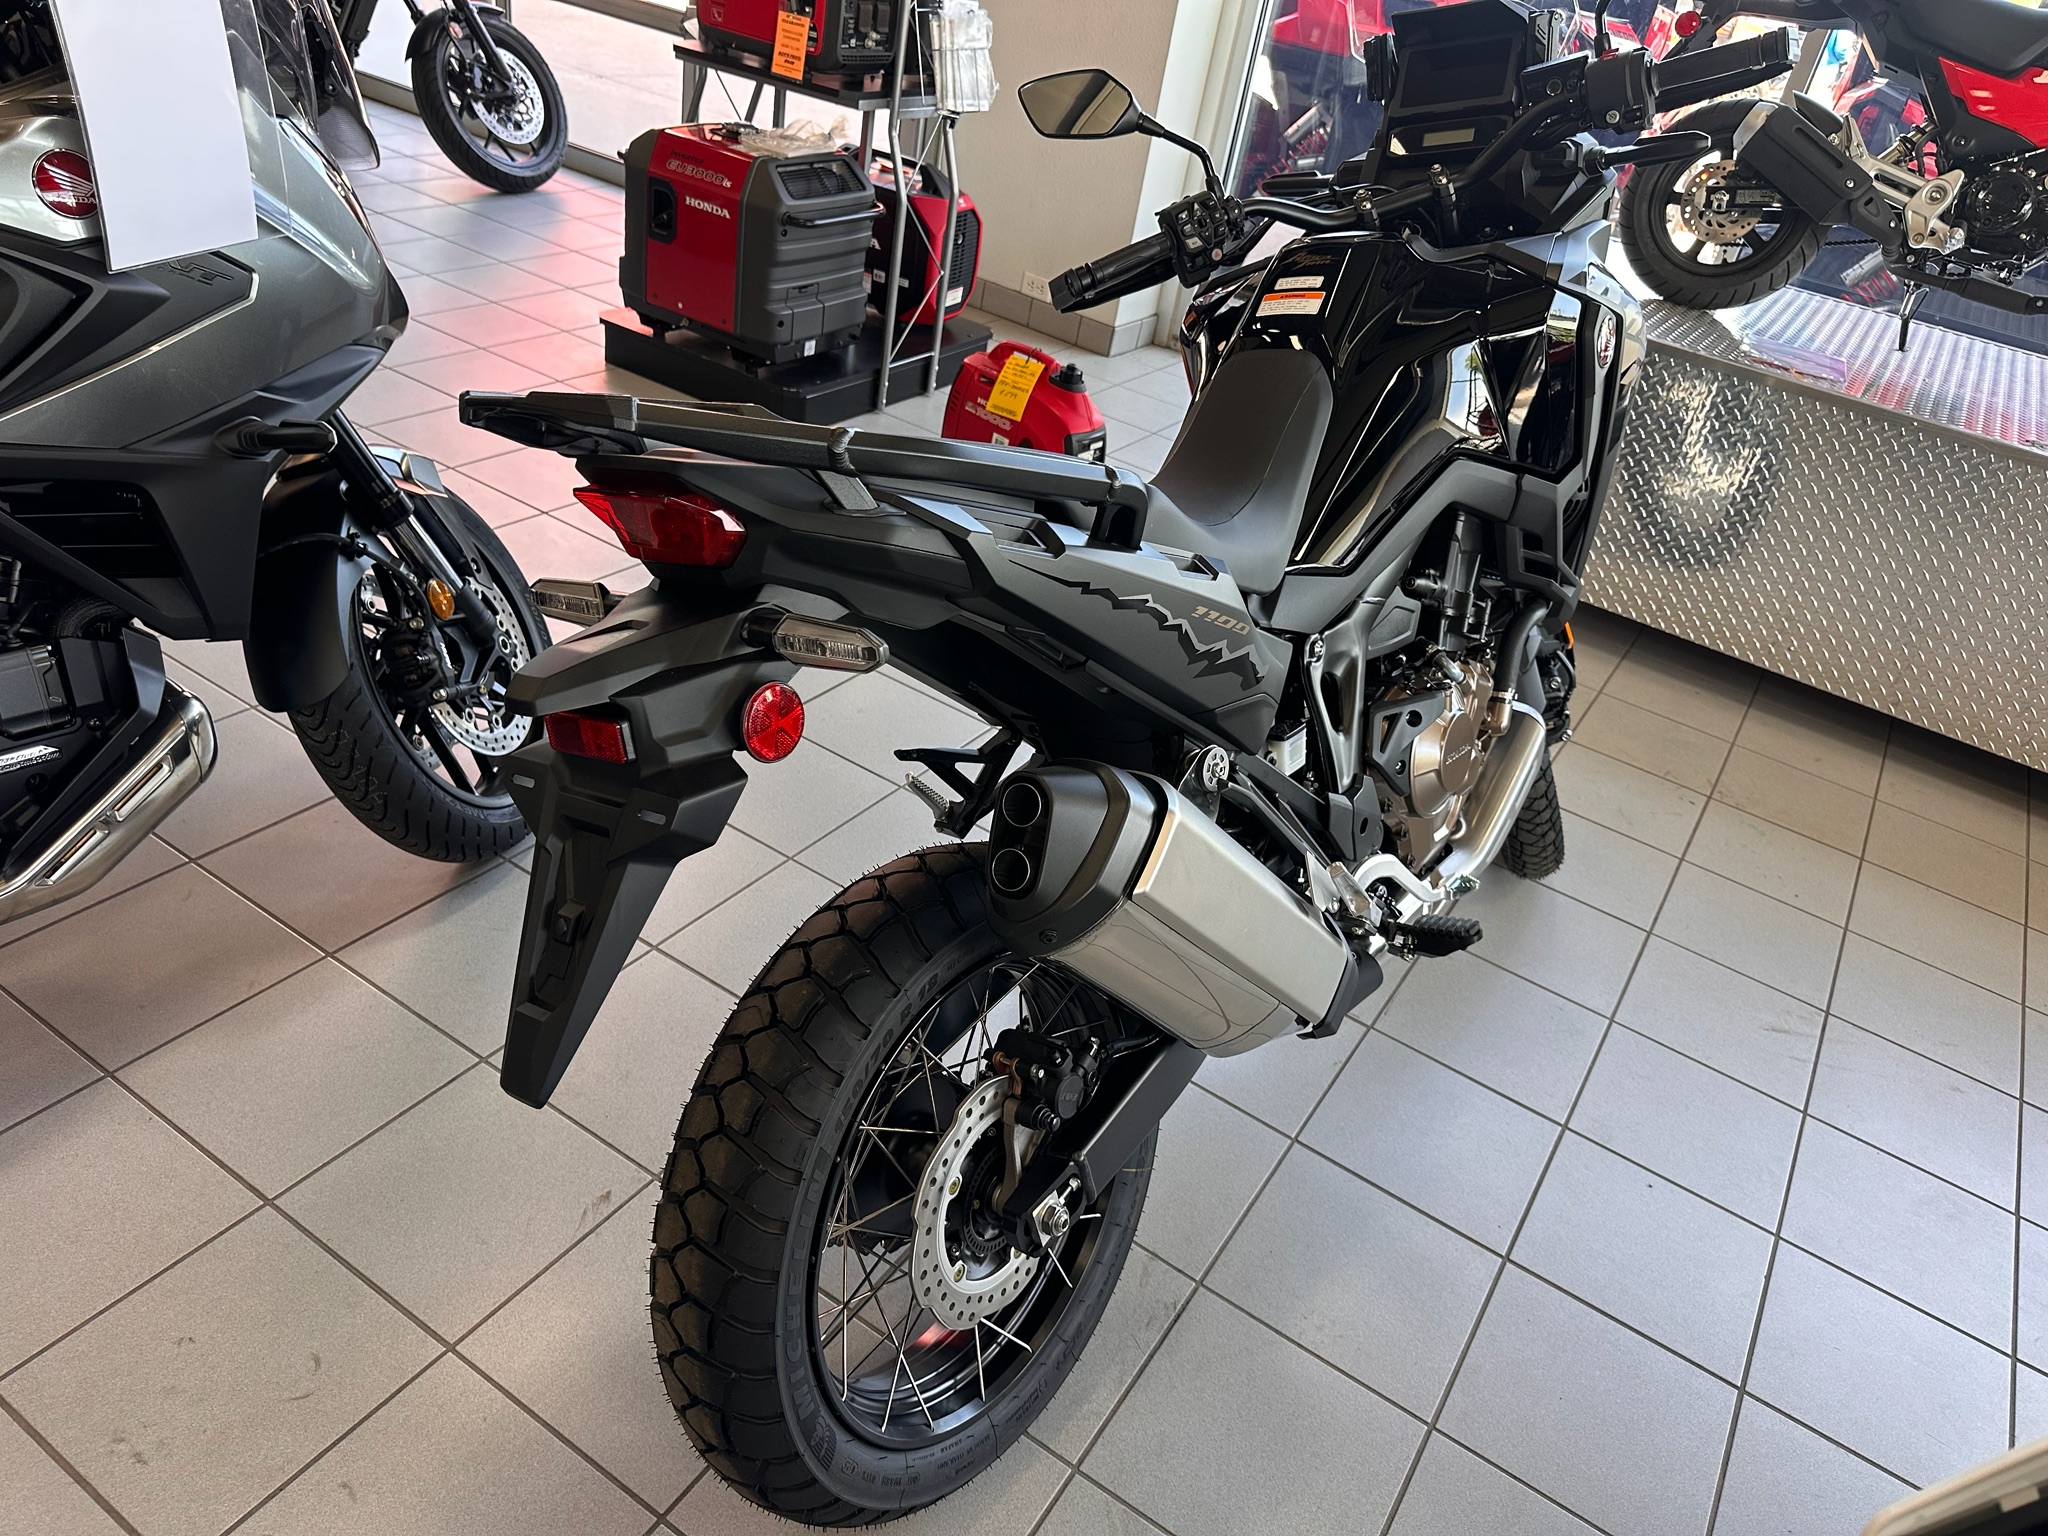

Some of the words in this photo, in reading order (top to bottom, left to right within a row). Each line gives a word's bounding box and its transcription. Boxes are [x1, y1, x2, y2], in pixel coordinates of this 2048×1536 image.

[685, 195, 731, 220] HONDA
[1191, 605, 1250, 636] 1100
[782, 1161, 828, 1421] MICHELIN
